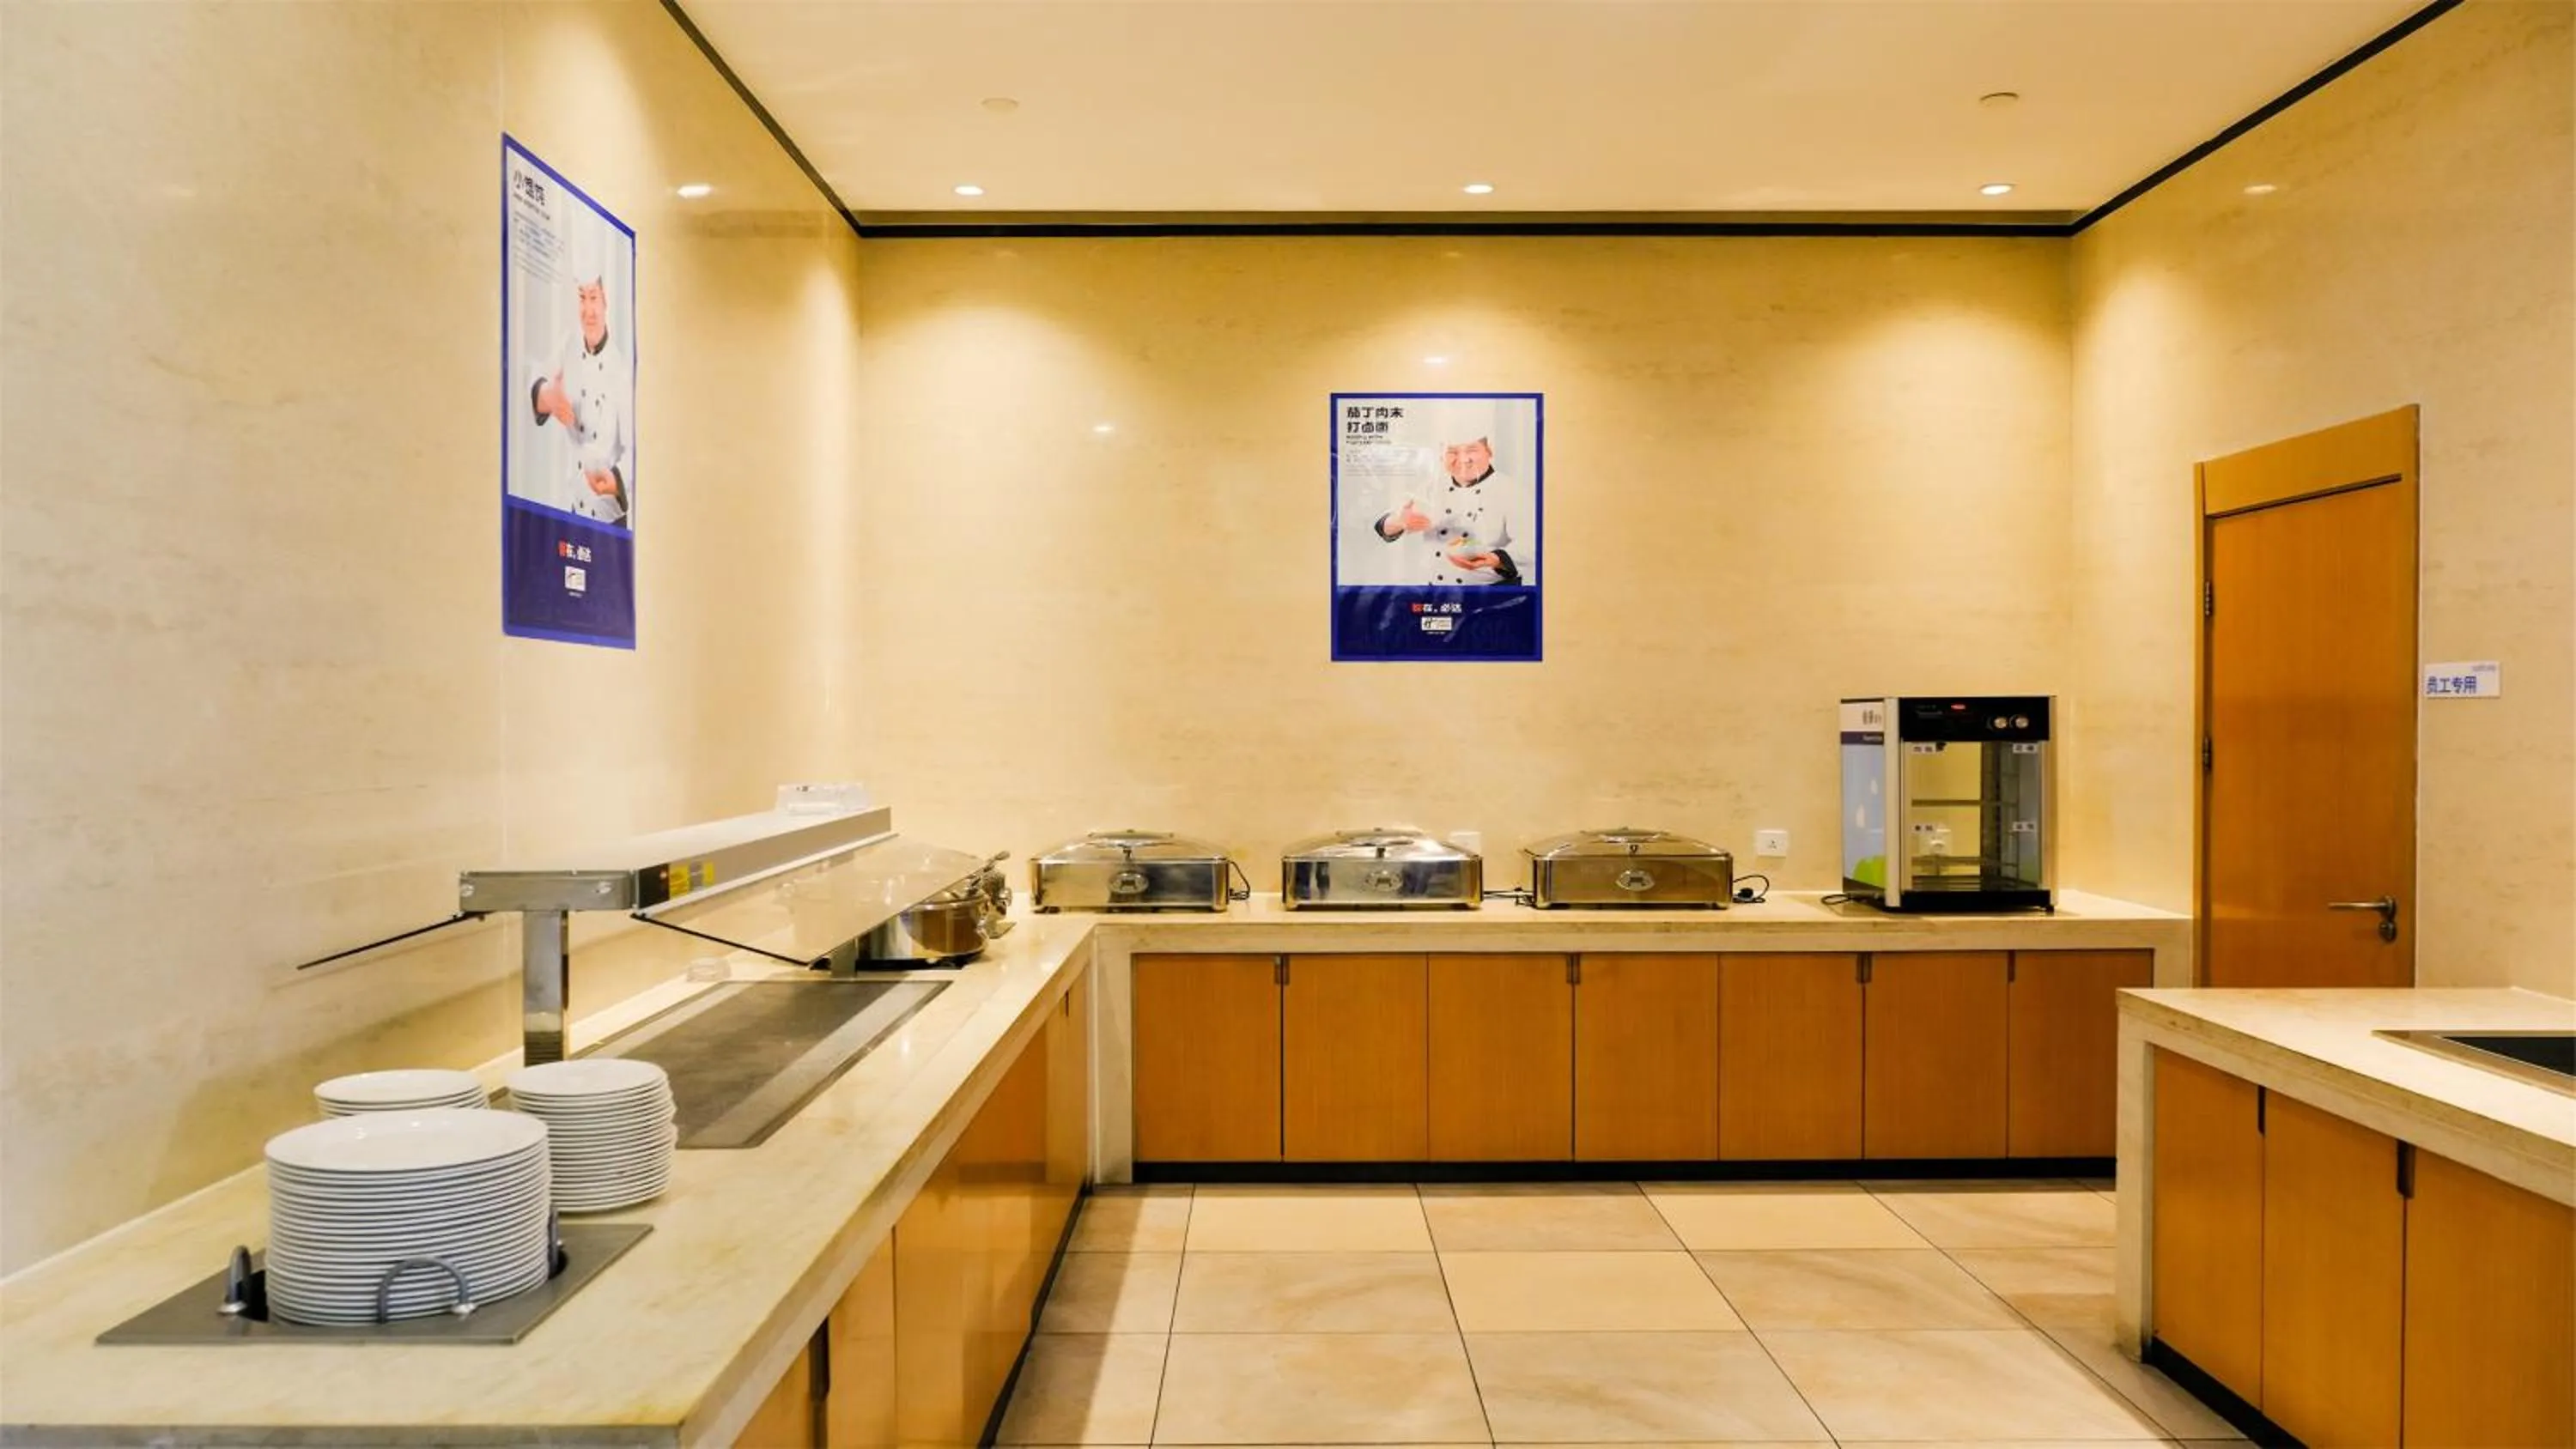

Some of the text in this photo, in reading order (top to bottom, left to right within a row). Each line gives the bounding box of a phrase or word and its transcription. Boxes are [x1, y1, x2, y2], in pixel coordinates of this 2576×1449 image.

[1346, 406, 1404, 418] 茄丁肉末
[2426, 676, 2477, 694] 员工专用
